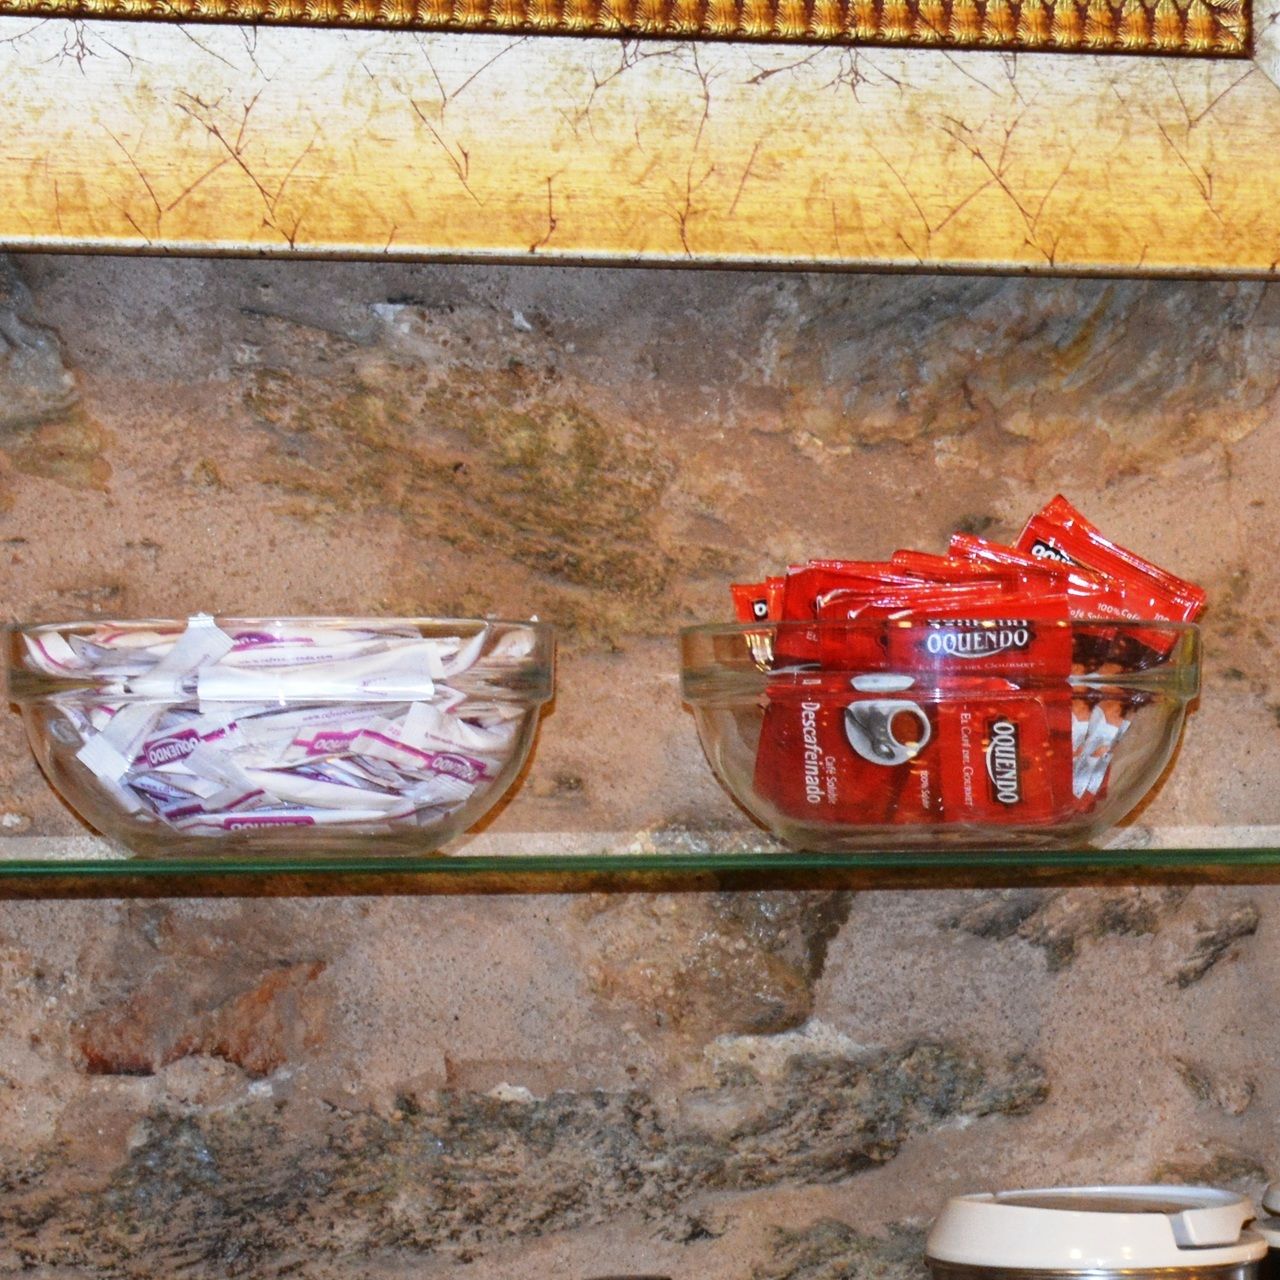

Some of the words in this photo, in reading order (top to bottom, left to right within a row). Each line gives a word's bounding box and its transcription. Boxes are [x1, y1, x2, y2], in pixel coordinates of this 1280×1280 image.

[926, 629, 1028, 658] OQUENDO
[149, 736, 201, 765] OQUENDO
[801, 701, 826, 804] Descafeinado
[988, 720, 1020, 804] OQUENDO
